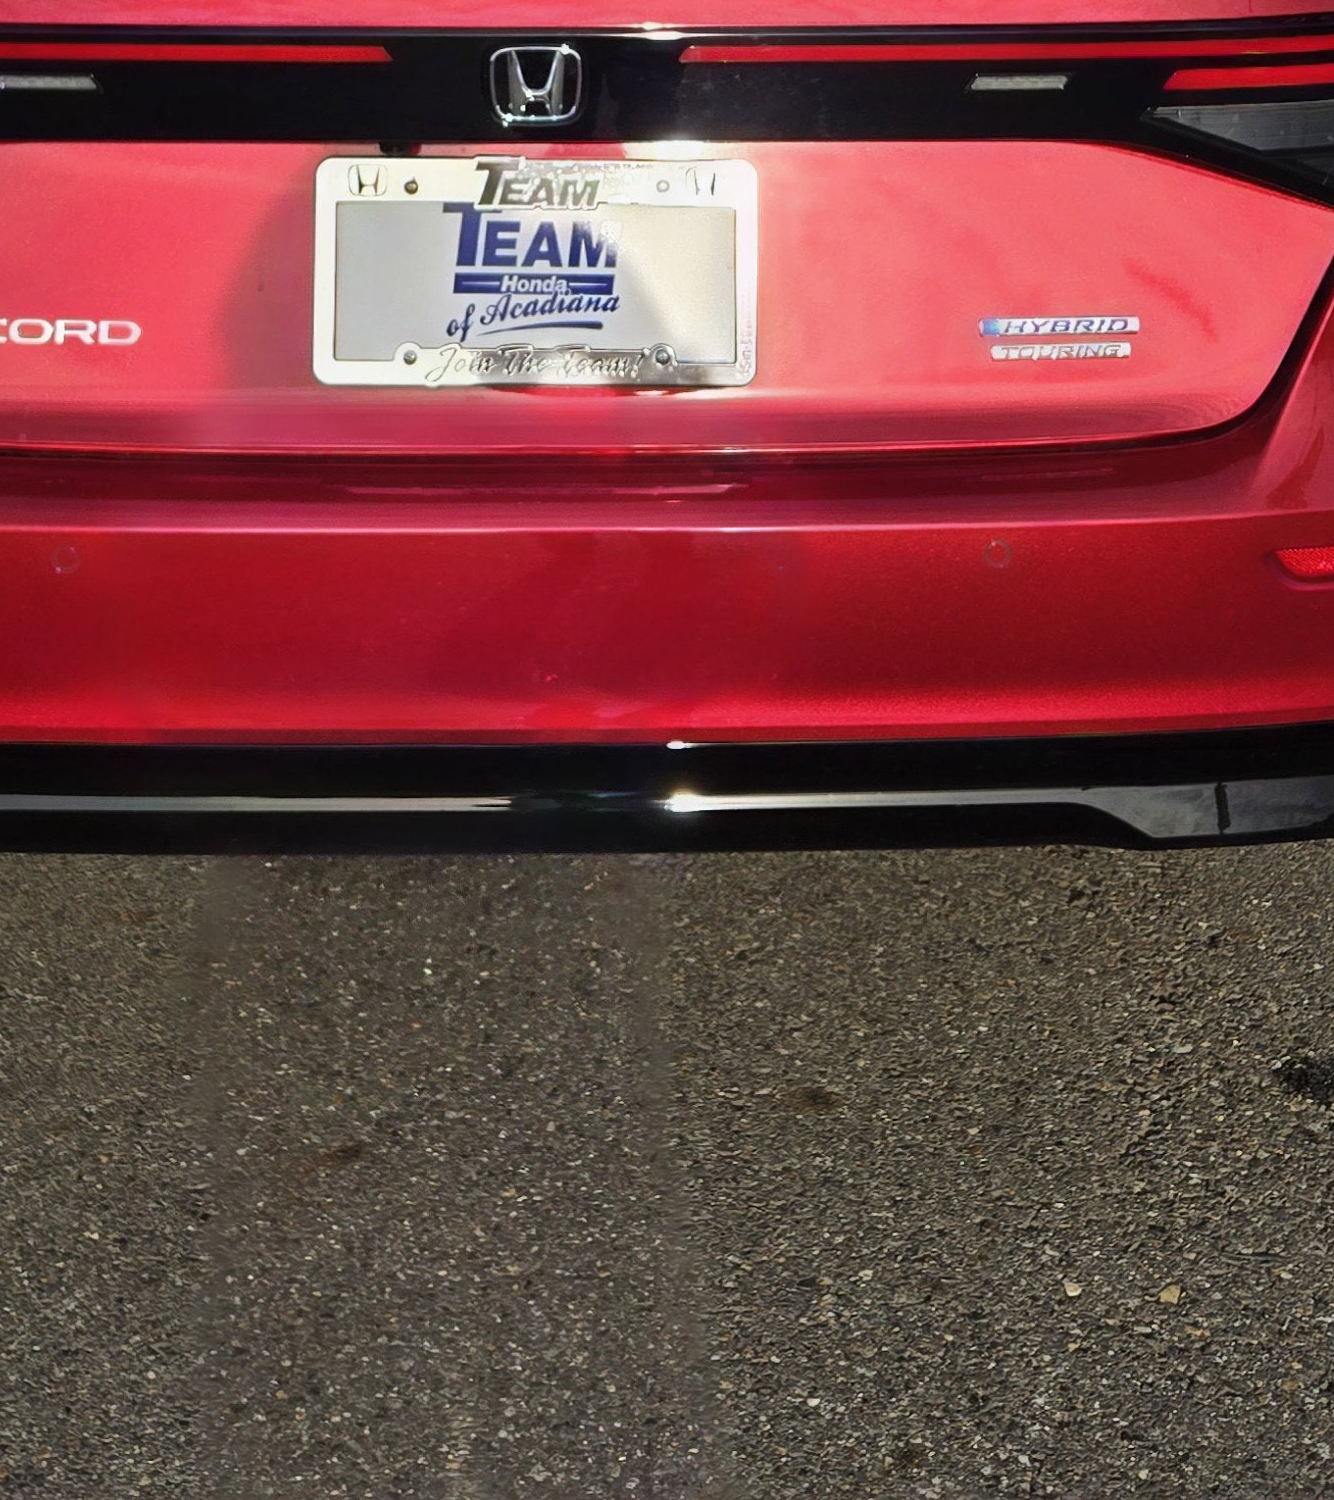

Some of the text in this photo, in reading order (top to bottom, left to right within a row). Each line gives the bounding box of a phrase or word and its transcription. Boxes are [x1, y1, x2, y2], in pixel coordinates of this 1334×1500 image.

[442, 203, 622, 269] TEAM
[500, 274, 568, 294] Honda
[446, 292, 621, 342] of Acadiana
[1003, 318, 1131, 334] HYBRID
[425, 346, 494, 382] Join
[498, 345, 552, 376] The
[1000, 344, 1122, 360] TOURING
